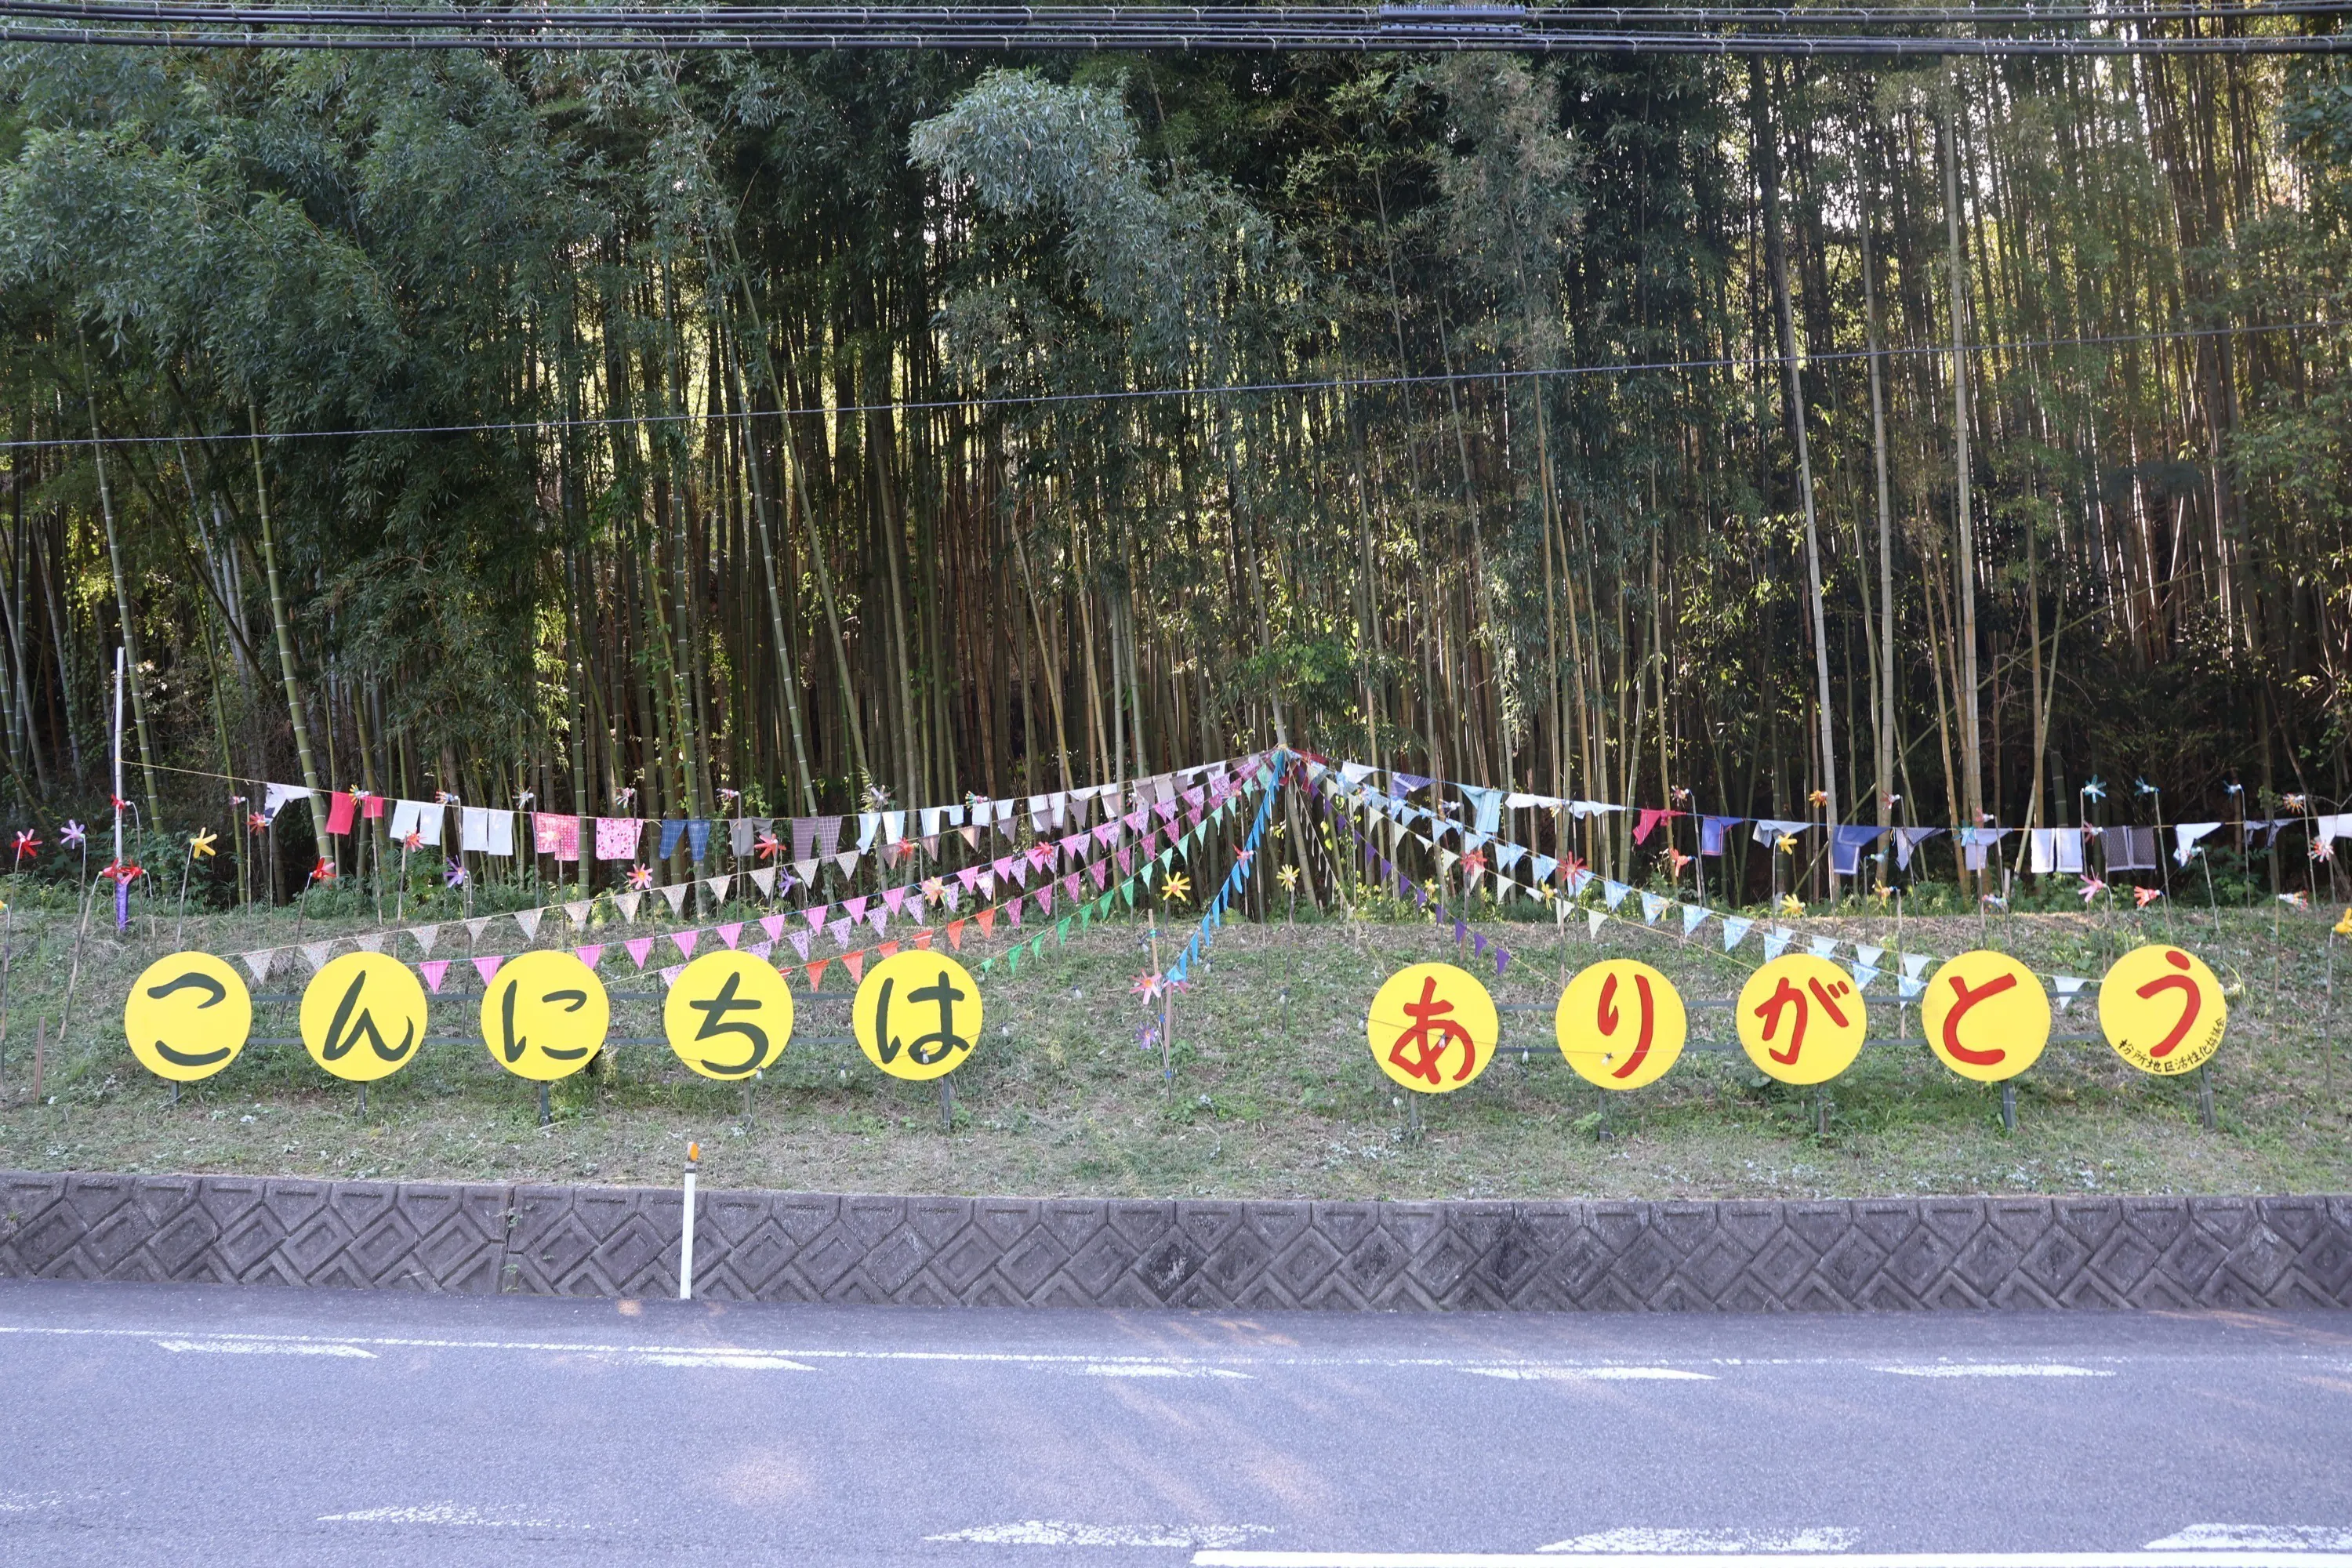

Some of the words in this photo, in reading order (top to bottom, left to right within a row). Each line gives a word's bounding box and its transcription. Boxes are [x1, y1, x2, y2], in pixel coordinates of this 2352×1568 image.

[147, 971, 970, 1075] こんにちは
[1388, 950, 2201, 1085] ありがとう
